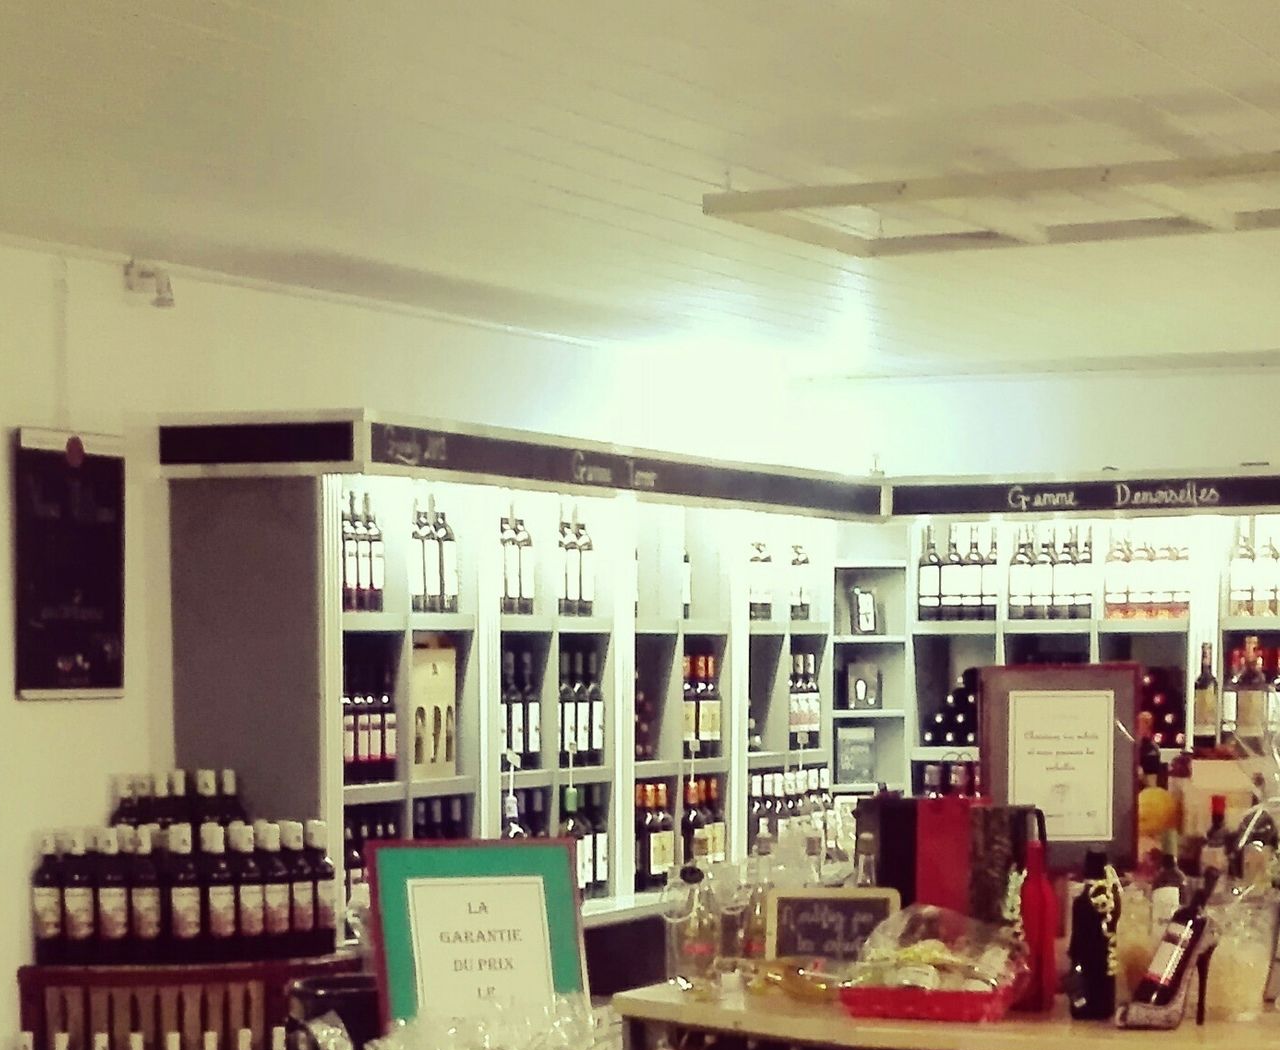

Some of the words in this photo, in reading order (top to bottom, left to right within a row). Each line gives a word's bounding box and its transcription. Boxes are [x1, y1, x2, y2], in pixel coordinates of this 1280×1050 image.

[1008, 484, 1076, 511] Gamme
[466, 901, 489, 914] LA
[439, 928, 523, 944] GARANTIE
[453, 959, 473, 972] DU
[477, 957, 515, 972] PRIX
